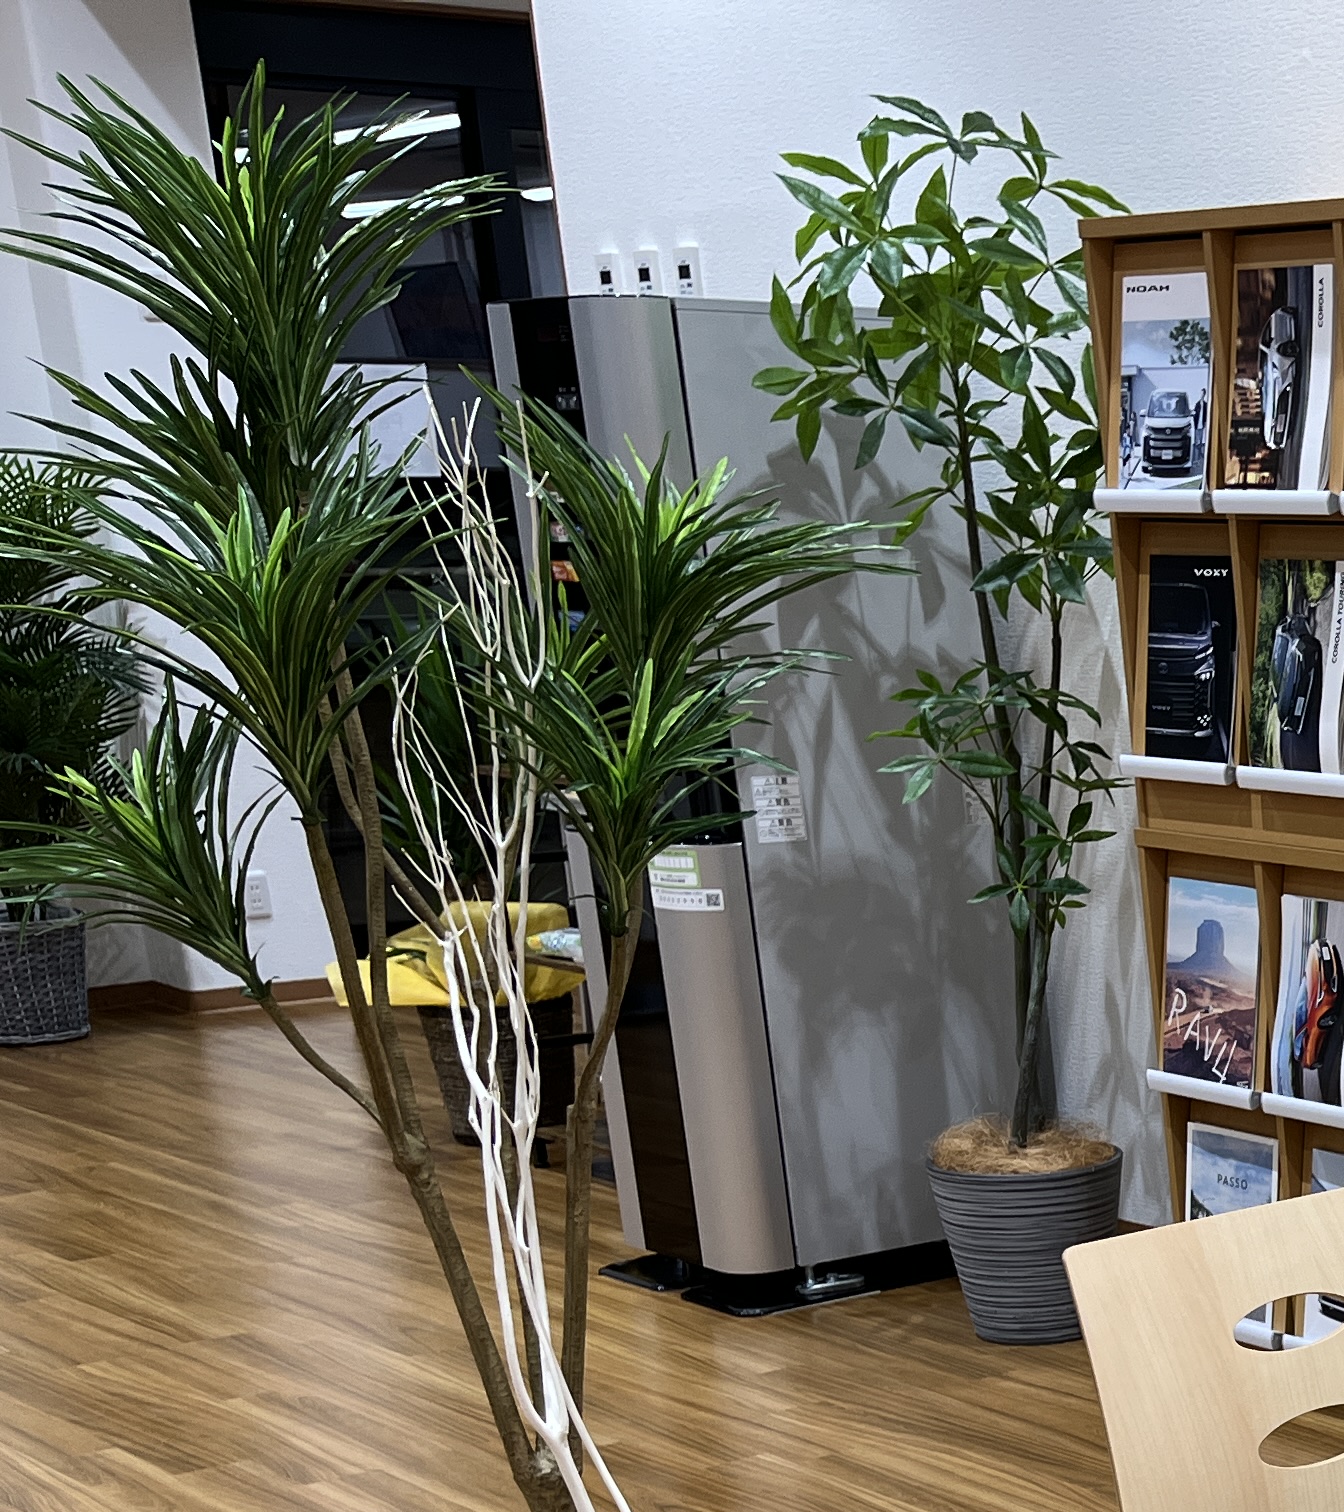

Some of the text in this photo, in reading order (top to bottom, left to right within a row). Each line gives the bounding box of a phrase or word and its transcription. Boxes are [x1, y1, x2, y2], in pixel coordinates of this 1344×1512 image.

[1126, 284, 1170, 294] NOAH
[1317, 277, 1325, 328] COROLLA
[1193, 568, 1228, 577] VOXY
[1331, 618, 1343, 664] COROLLA
[1168, 988, 1237, 1084] RAV4
[1217, 1173, 1248, 1191] PASSO
